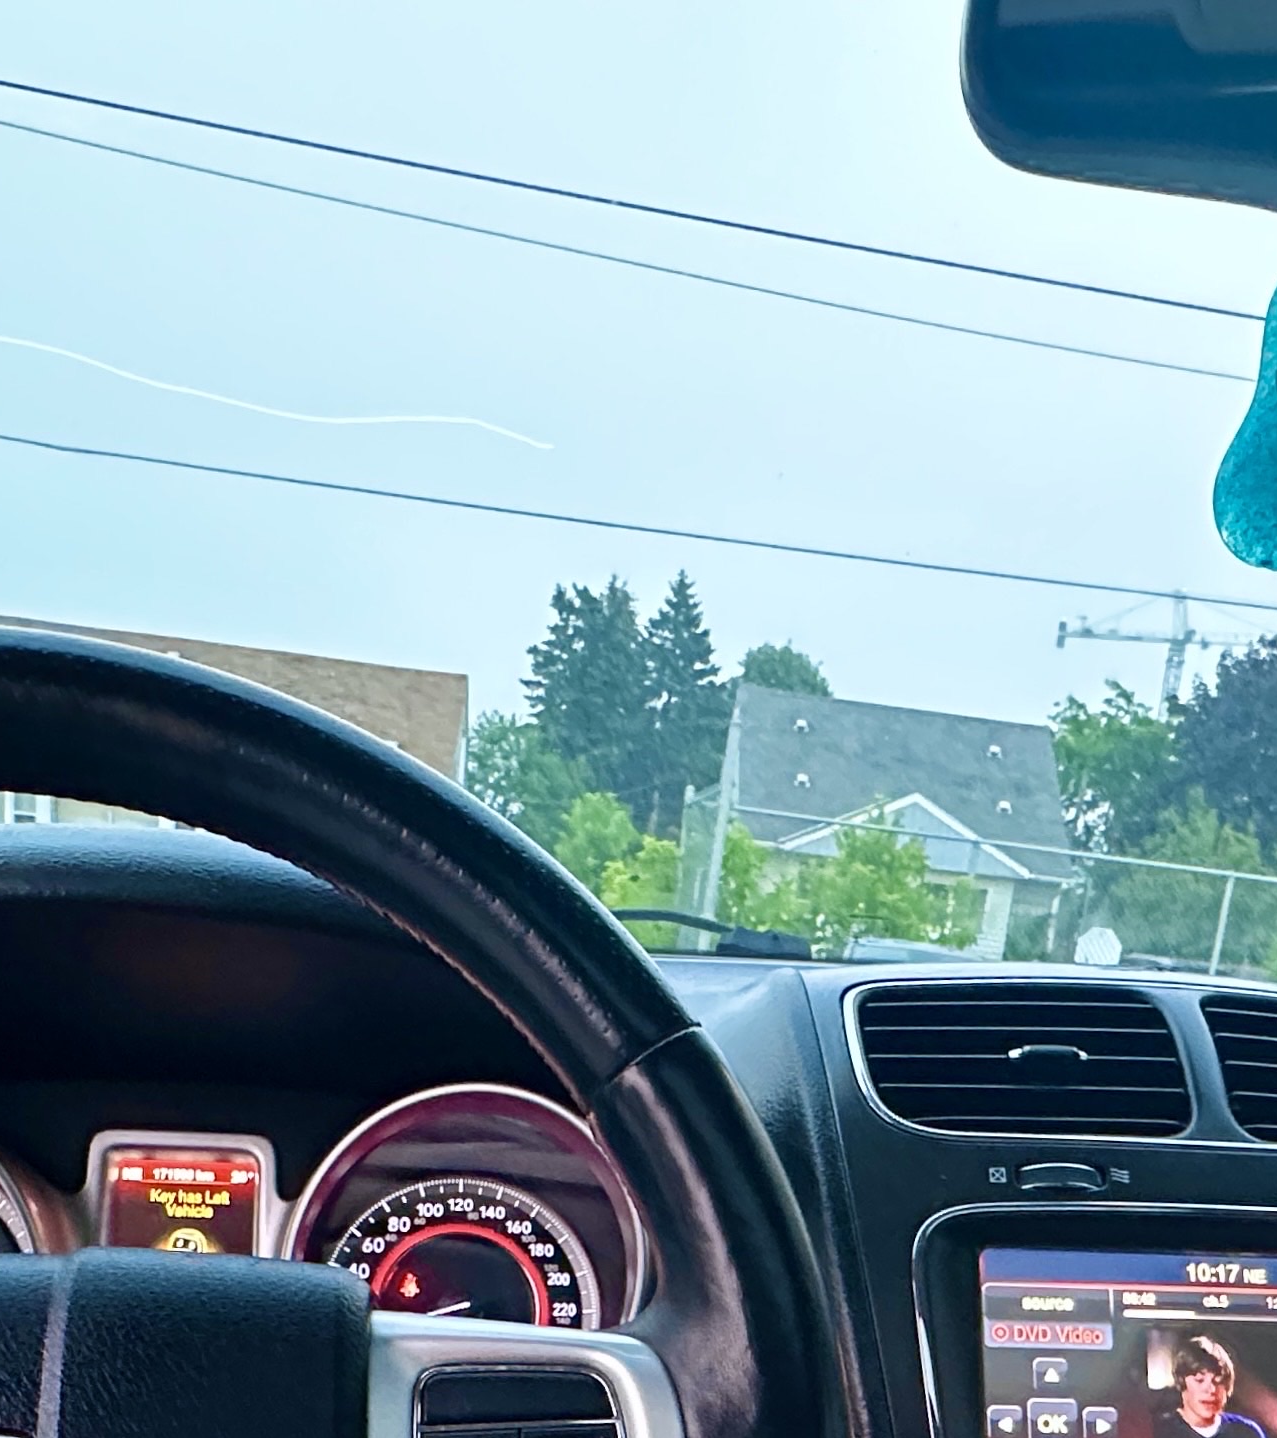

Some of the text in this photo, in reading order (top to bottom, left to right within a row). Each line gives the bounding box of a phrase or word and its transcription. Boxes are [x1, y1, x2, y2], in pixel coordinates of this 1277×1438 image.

[149, 1188, 230, 1205] Key has Left
[166, 1204, 214, 1218] Vehicle
[349, 1198, 577, 1317] 40 60 80 100 120 140 160 180 200 220
[1186, 1263, 1240, 1283] 10:17
[1243, 1269, 1267, 1284] NE
[1022, 1297, 1074, 1311] source
[1013, 1325, 1103, 1344] DVD Video
[1037, 1413, 1069, 1434] OK
